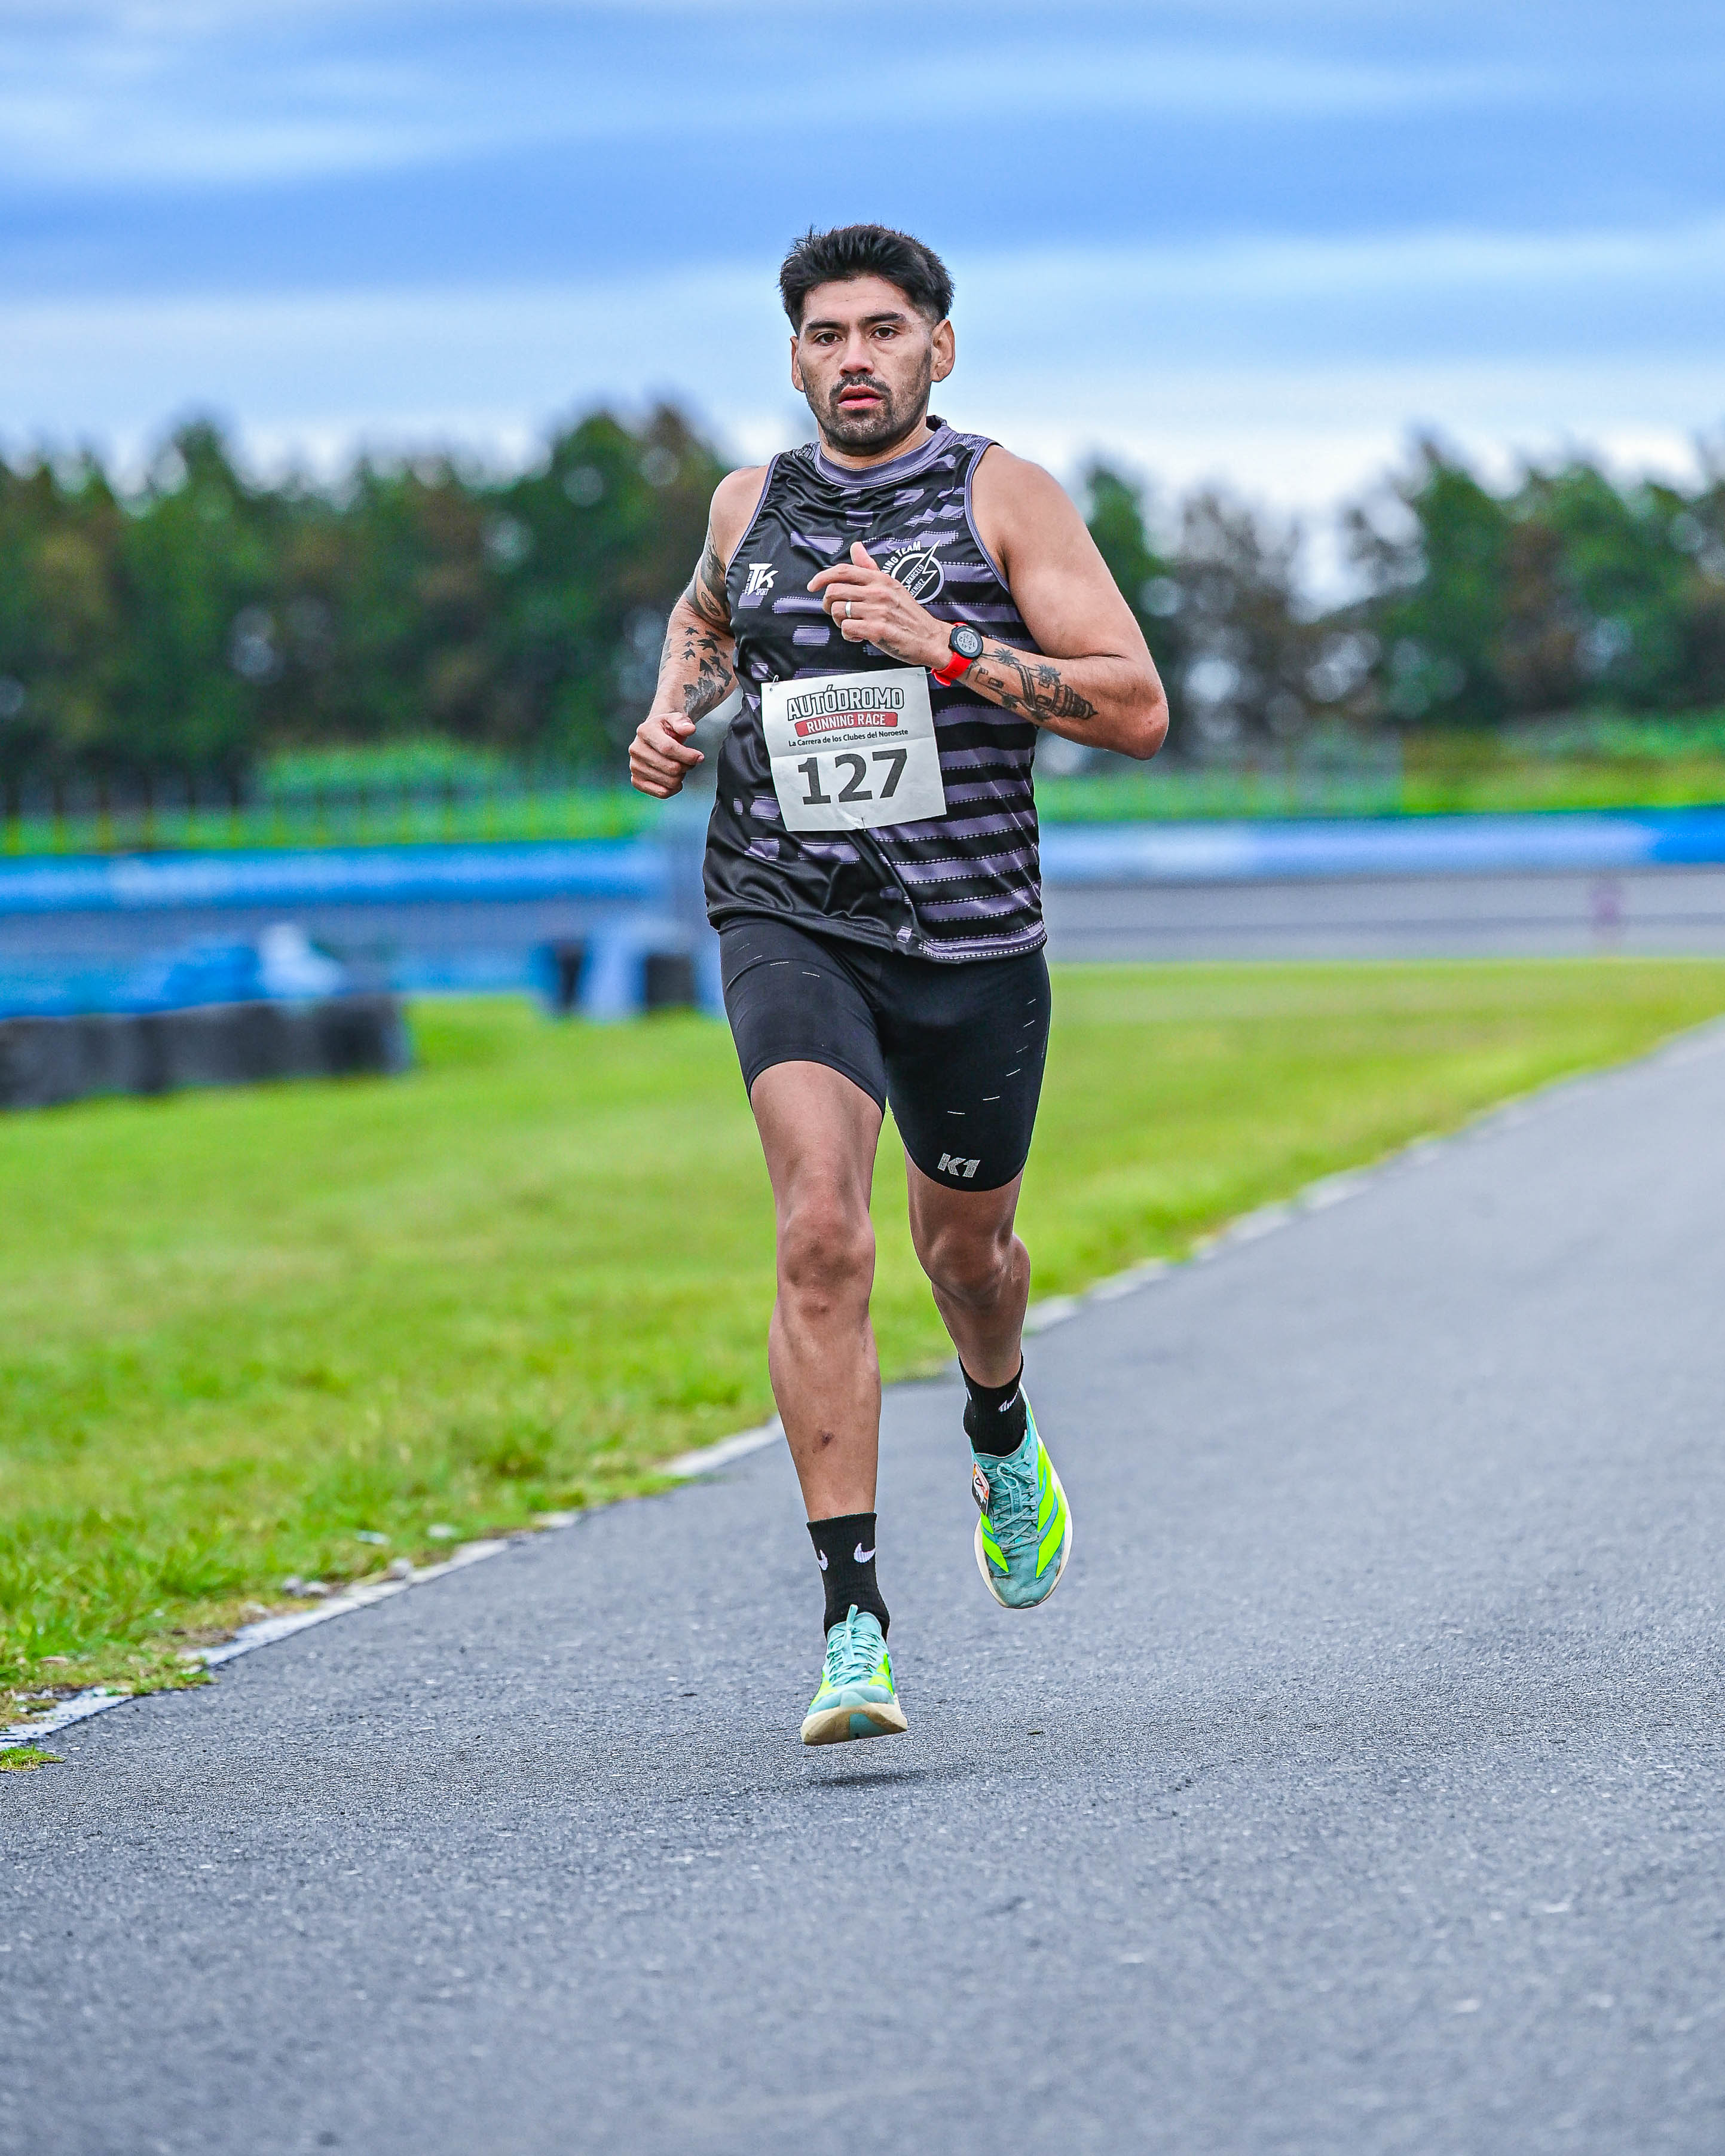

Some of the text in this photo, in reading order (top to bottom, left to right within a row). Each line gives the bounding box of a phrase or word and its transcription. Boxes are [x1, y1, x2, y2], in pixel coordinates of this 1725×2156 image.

[895, 540, 921, 557] TEAM
[905, 564, 924, 585] MARCELO
[755, 588, 770, 596] SPORT
[787, 684, 905, 721] AUTÓDROMO
[806, 714, 886, 733] RUNNING RACE
[843, 733, 865, 741] Clubes
[879, 729, 909, 738] Noroeste
[797, 748, 908, 805] 127
[937, 1153, 981, 1178] K1
